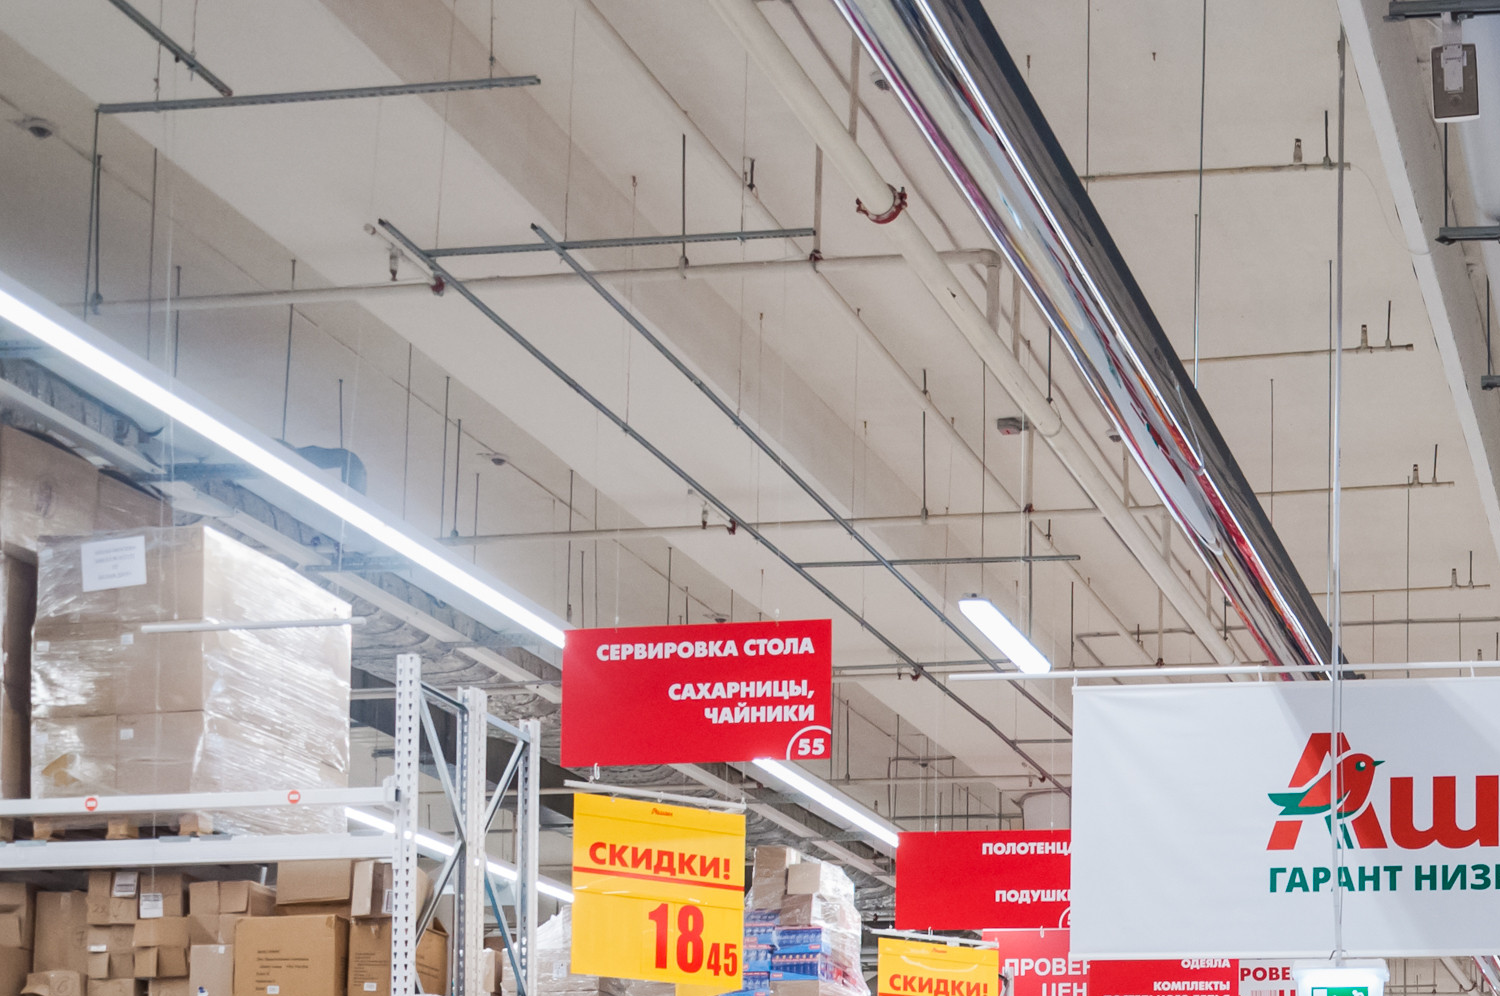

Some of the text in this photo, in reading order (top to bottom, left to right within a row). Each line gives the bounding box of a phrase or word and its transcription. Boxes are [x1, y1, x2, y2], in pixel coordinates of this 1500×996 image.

[597, 637, 815, 662] СЕРВИРОВКА СТОЛА
[668, 679, 815, 701] САХАРНИЦЫ,
[704, 702, 815, 724] ЧАЙНИКИ
[798, 738, 825, 756] 55
[588, 841, 732, 880] СКИДКИ!
[1268, 864, 1403, 894] ГАРАНТ
[1181, 959, 1230, 969] ОДЕЯЛА
[1153, 981, 1230, 991] КОМПЛЕКТЫ
